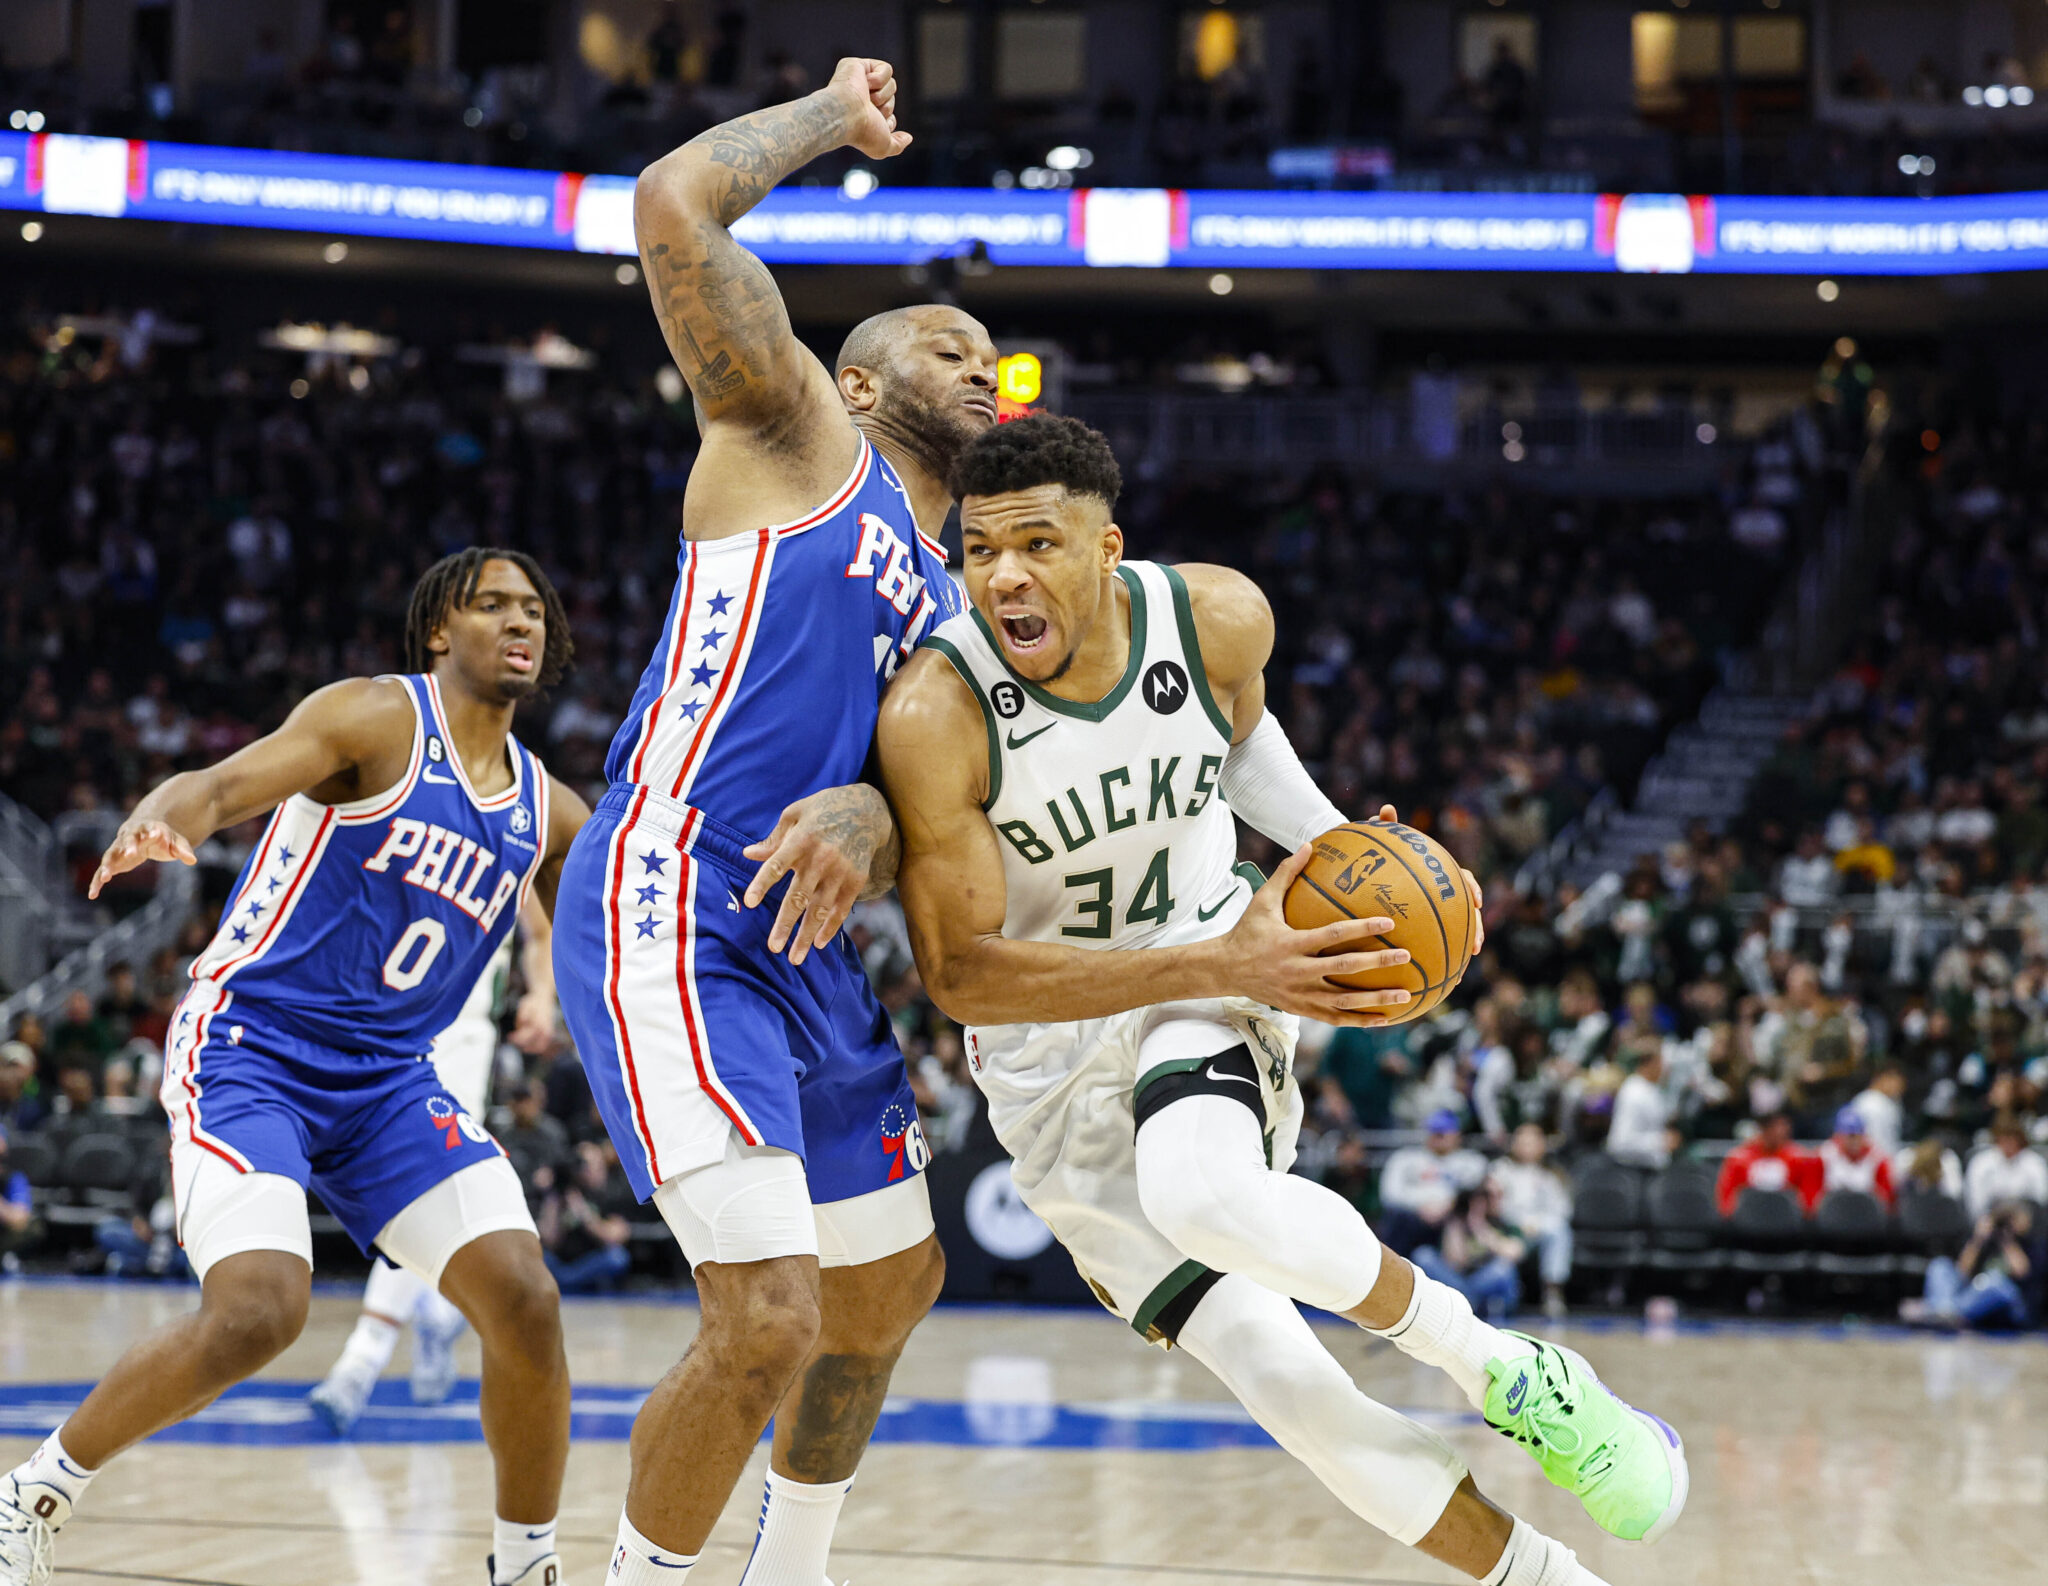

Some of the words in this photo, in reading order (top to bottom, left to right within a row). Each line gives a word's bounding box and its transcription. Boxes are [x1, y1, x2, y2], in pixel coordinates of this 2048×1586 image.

[996, 687, 1018, 714] 6
[996, 755, 1223, 865] BUCKS
[362, 816, 518, 935] PHILA
[1061, 847, 1176, 939] 34
[382, 916, 447, 992] 0
[430, 1112, 490, 1152] 76
[881, 1120, 927, 1183] 76
[1505, 1369, 1528, 1405] FREAK
